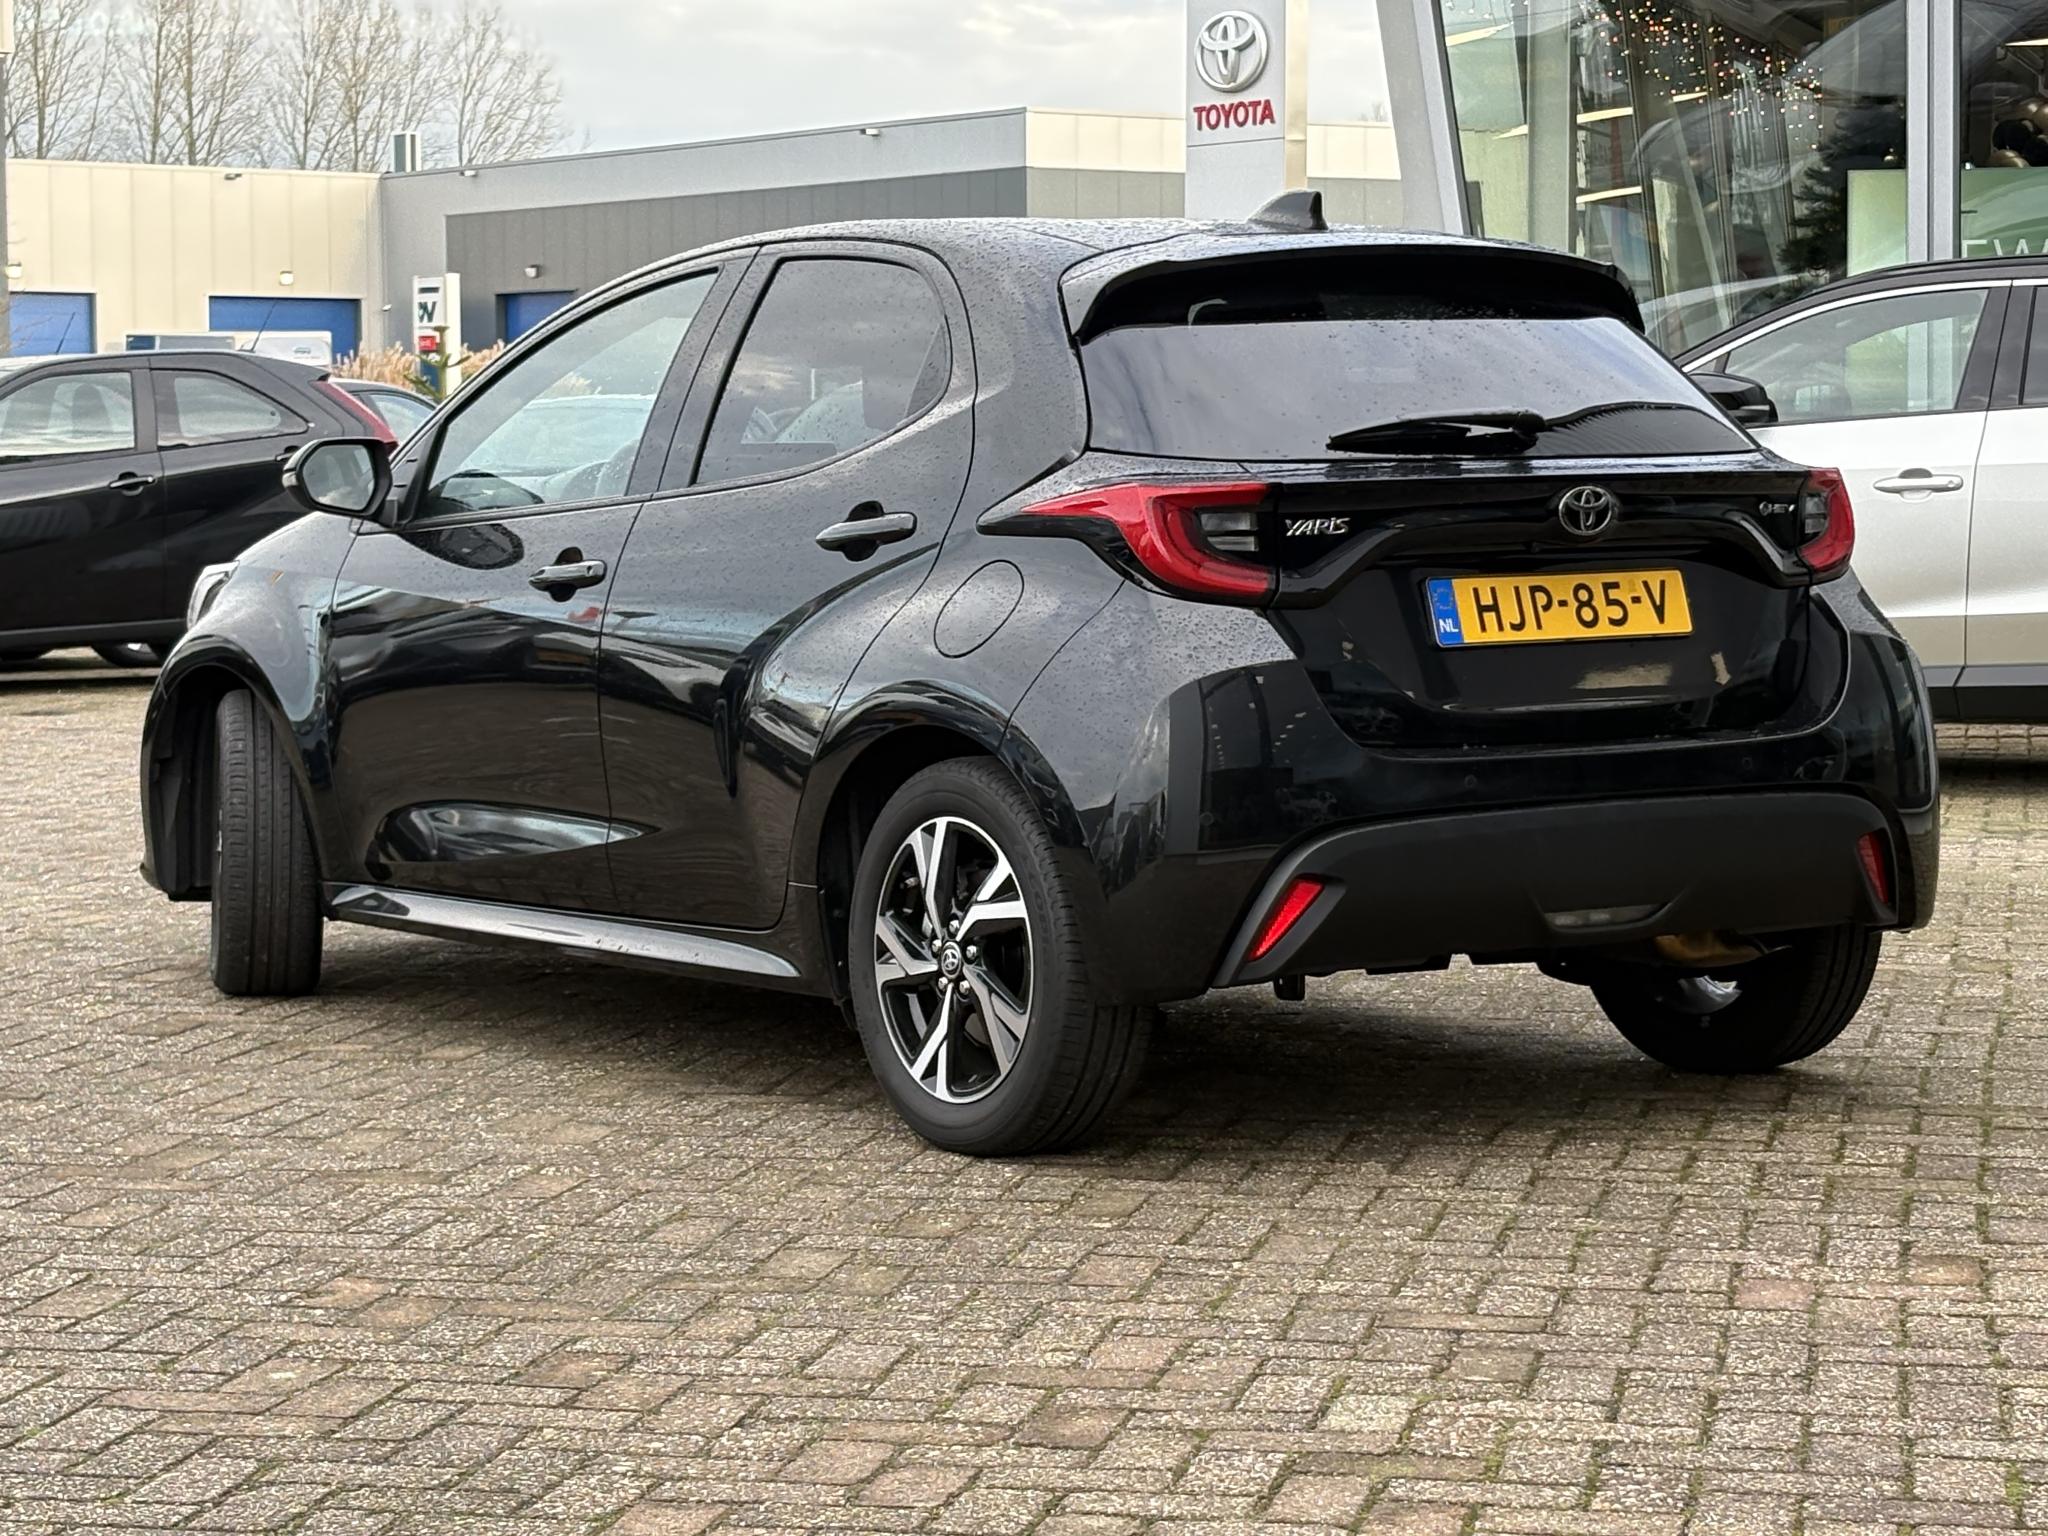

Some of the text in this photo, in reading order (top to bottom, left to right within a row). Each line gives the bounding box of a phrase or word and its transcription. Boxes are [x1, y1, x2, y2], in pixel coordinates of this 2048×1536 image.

[1193, 99, 1276, 131] TOYOTA
[1285, 517, 1351, 536] YARIS
[1472, 579, 1666, 633] HJP-85-V
[1439, 618, 1459, 633] NL
